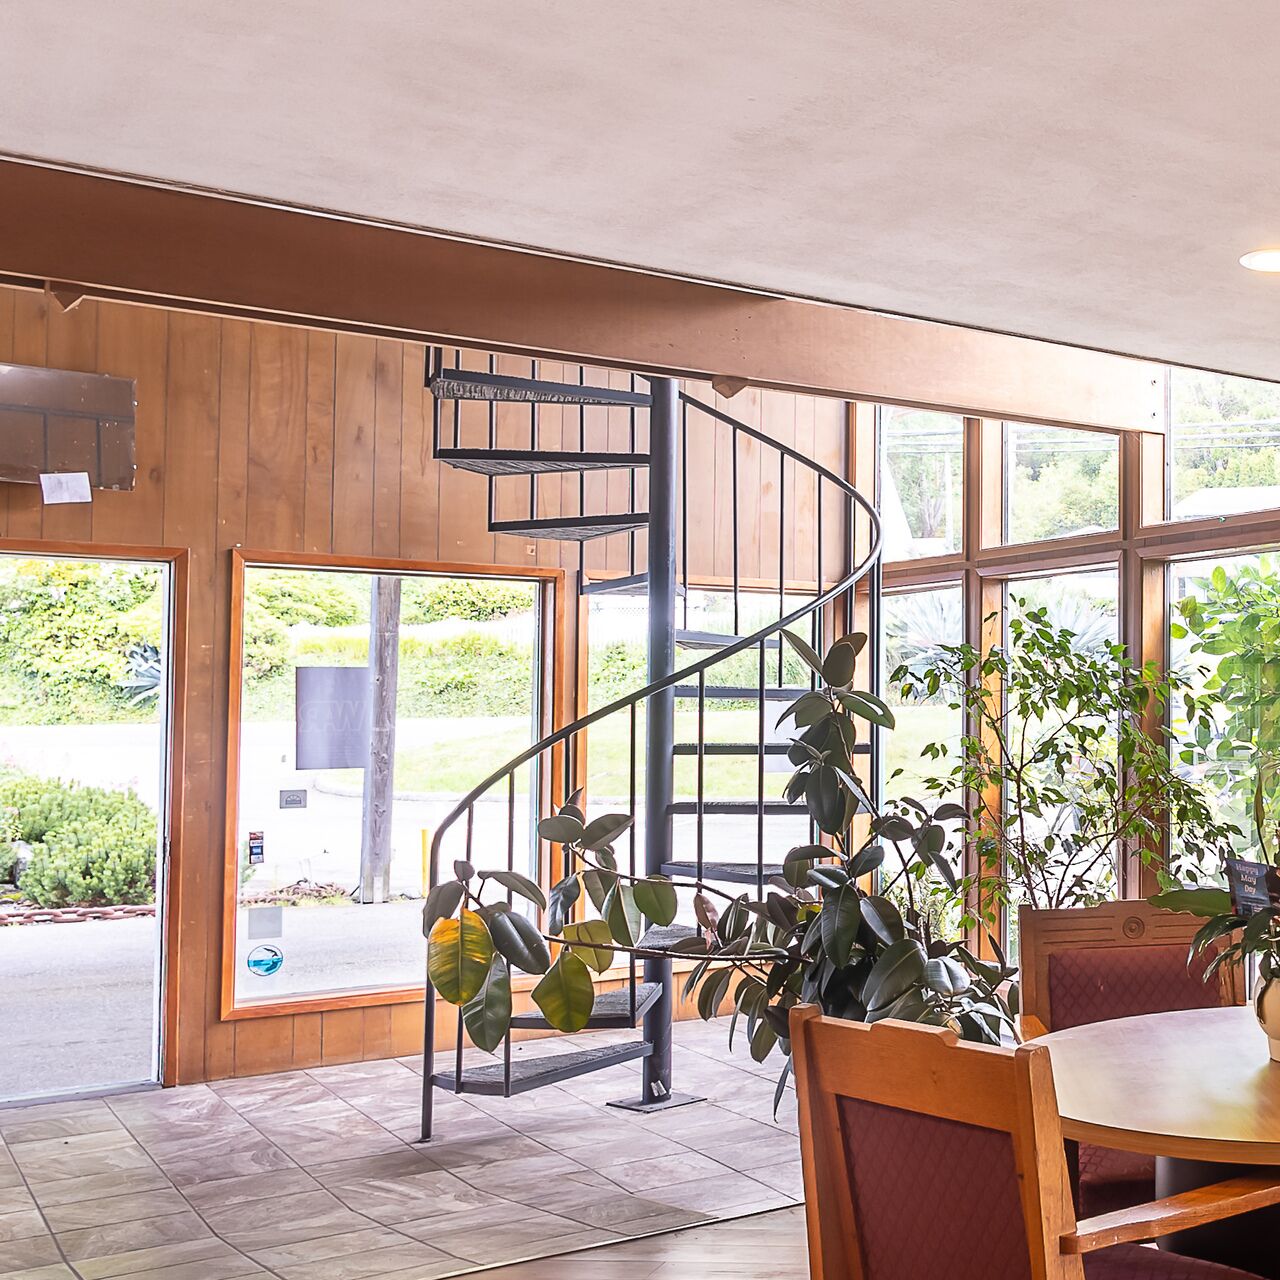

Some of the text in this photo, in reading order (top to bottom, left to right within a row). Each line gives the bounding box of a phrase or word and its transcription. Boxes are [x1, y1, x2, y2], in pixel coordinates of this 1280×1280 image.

[1235, 863, 1259, 876] Happy
[1240, 874, 1257, 885] May
[1244, 884, 1257, 895] Day
